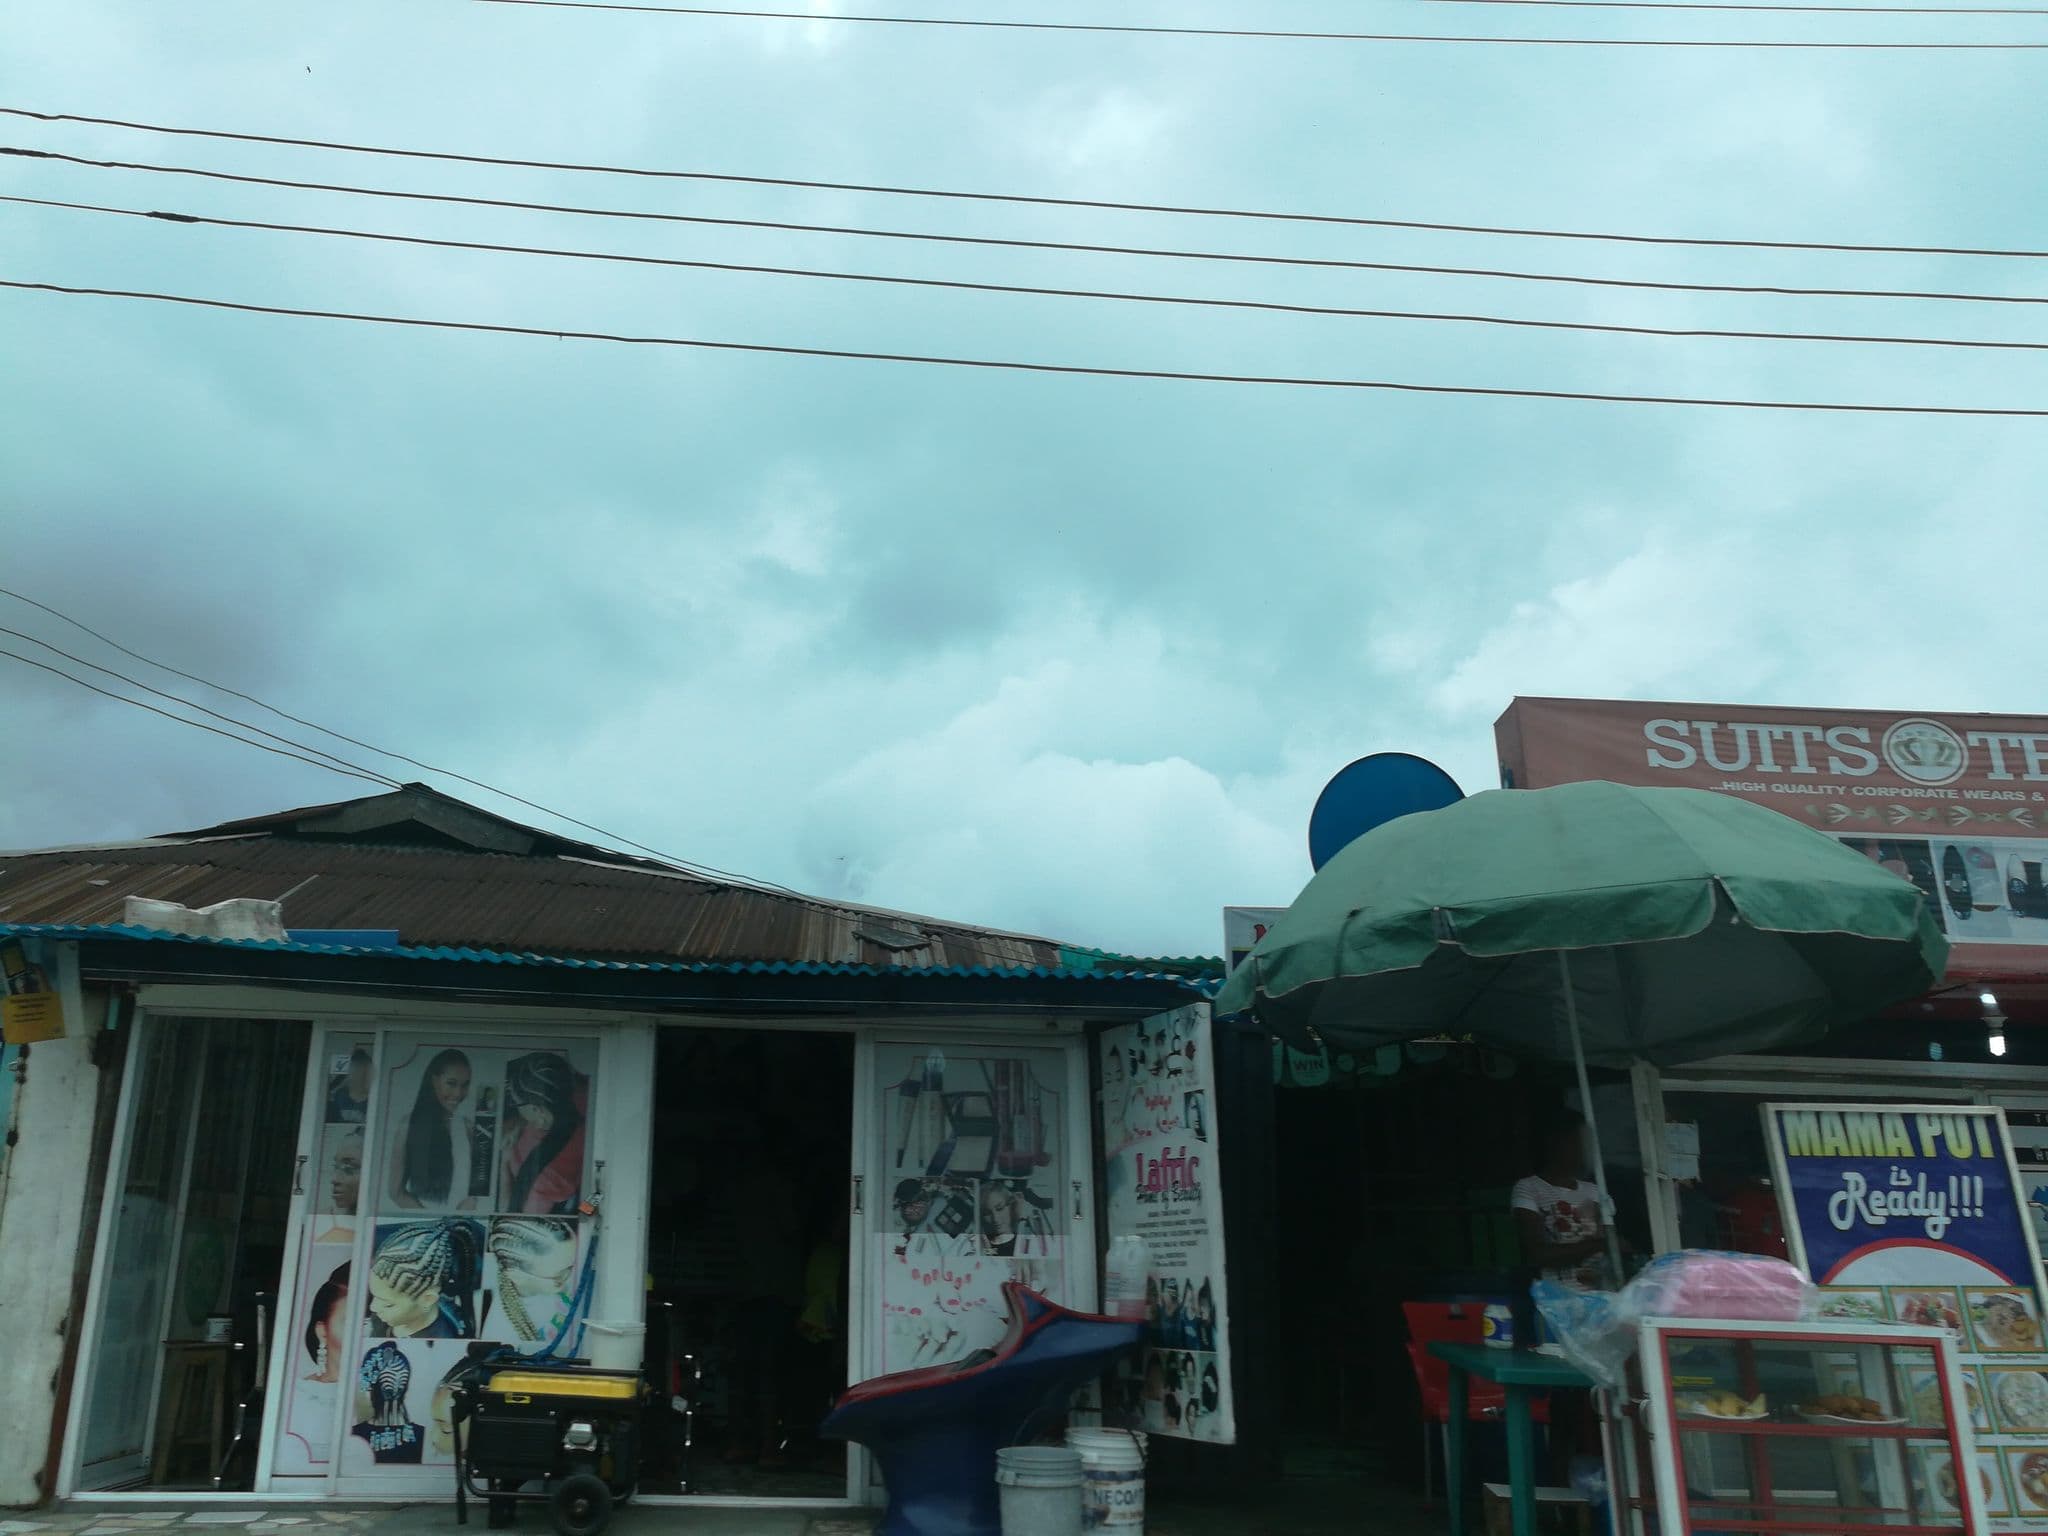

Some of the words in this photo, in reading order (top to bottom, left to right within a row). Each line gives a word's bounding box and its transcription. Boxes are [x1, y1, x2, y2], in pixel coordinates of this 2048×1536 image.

[1644, 719, 1880, 778] SUITS
[1770, 783, 1845, 796] QUALITY
[1852, 786, 1959, 800] CORPORATE
[1963, 789, 2026, 802] WEARS
[2032, 791, 2046, 803] &
[1782, 1111, 1915, 1157] MAMA
[1889, 1165, 1912, 1186] is
[1827, 1171, 1985, 1240] Ready!!!
